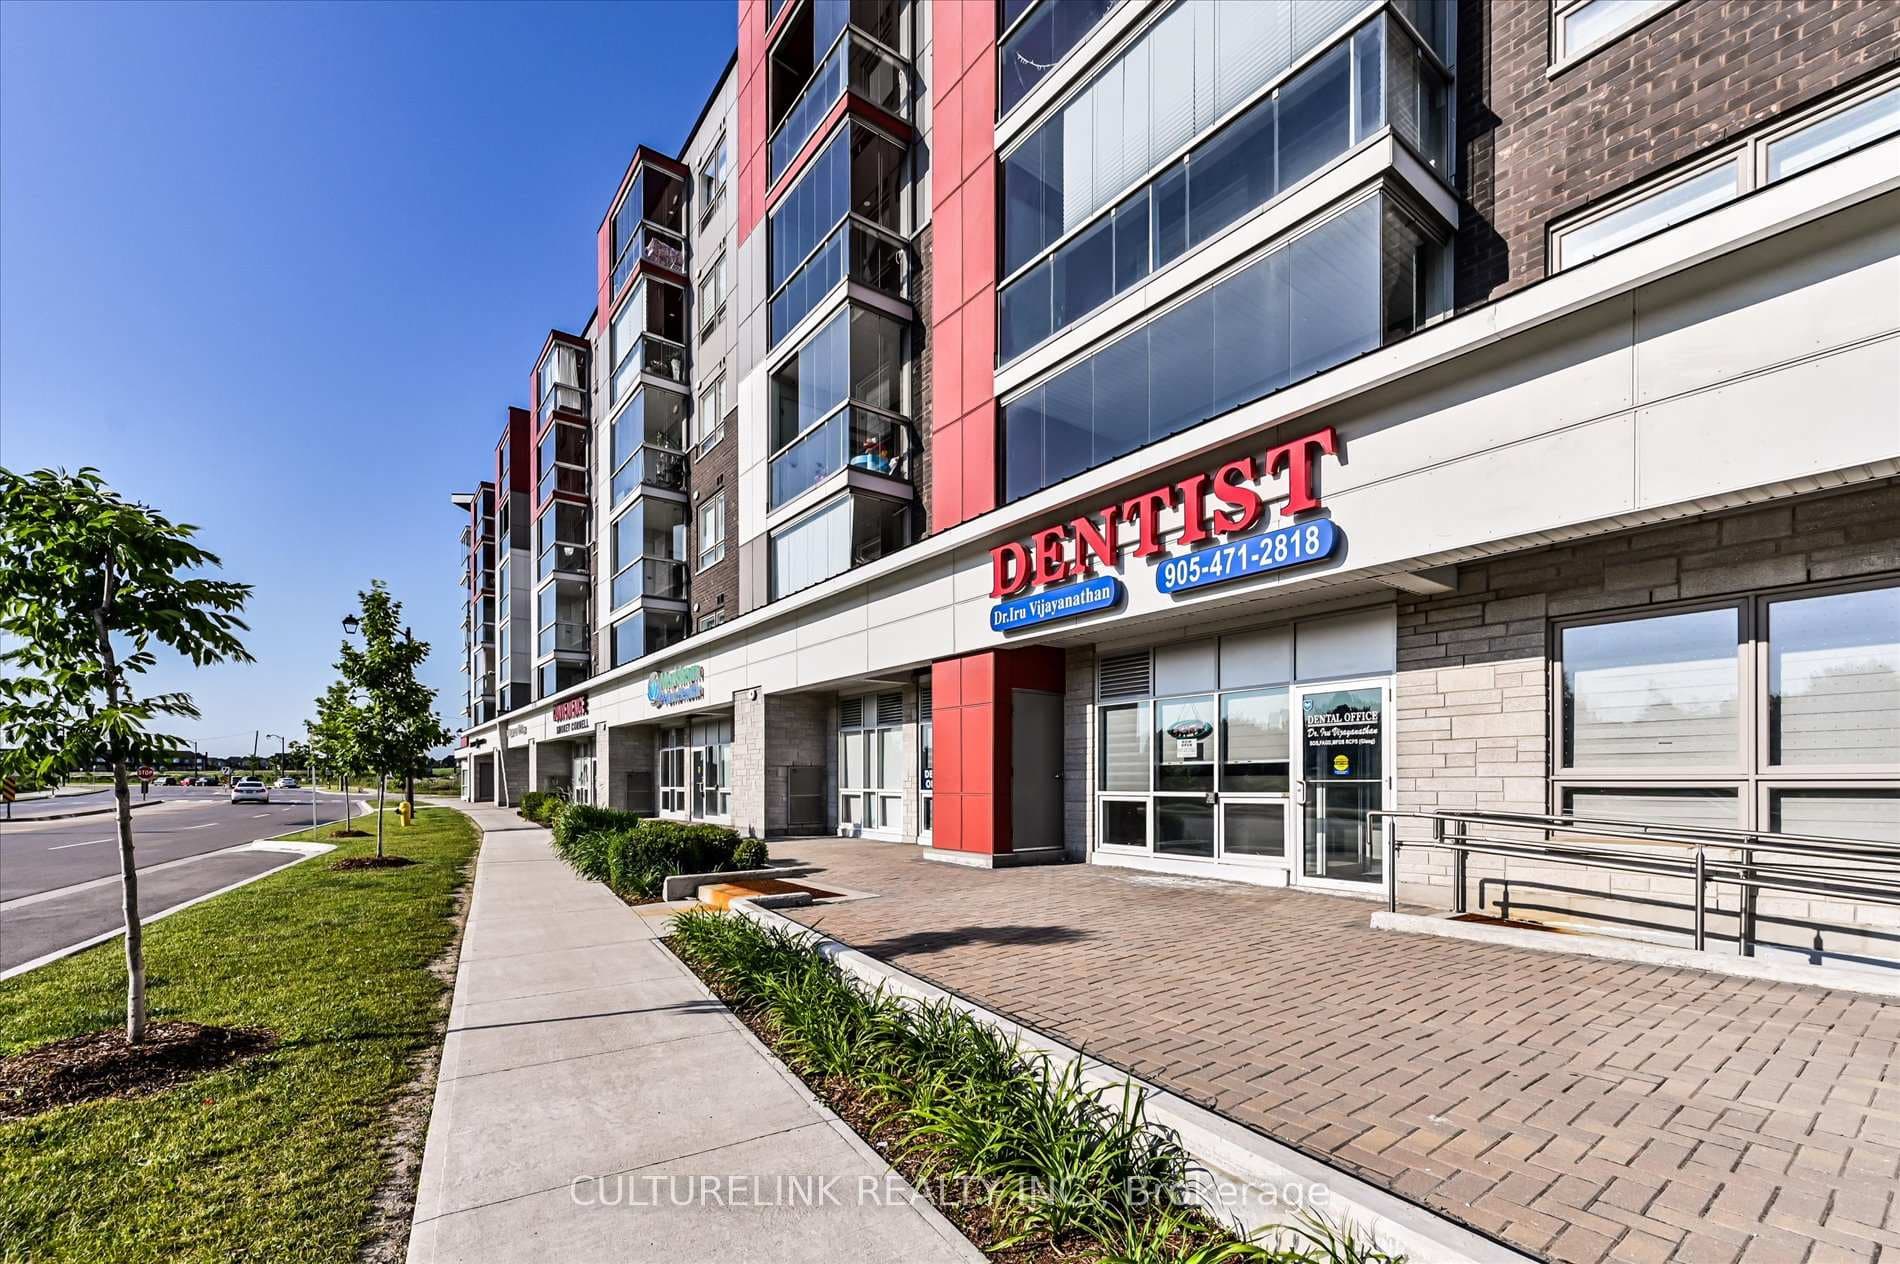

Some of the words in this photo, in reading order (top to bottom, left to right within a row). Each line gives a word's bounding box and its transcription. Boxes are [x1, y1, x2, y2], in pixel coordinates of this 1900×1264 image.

[989, 427, 1337, 598] DENTIST
[1164, 525, 1320, 589] 905-471-2818
[994, 607, 1026, 626] Dr.Iru
[1029, 586, 1110, 617] Vijayanathan
[1307, 713, 1343, 724] DENTAL
[1344, 710, 1378, 722] OFFICE
